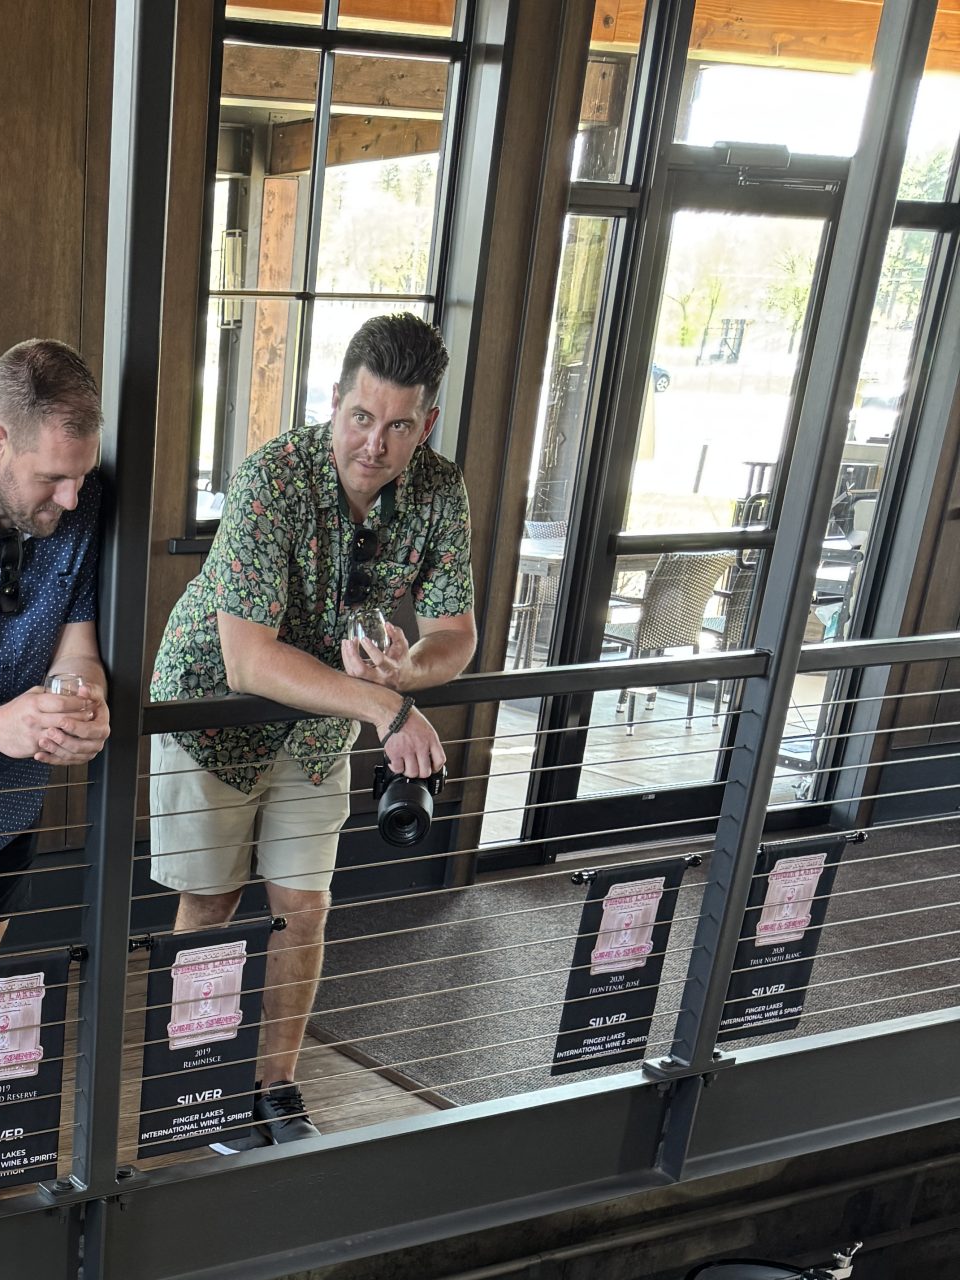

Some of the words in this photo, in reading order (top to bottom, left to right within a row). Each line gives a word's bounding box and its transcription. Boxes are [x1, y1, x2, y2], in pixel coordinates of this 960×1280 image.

[764, 955, 784, 963] NORTH
[589, 984, 624, 994] FRONTENAC
[752, 984, 785, 997] SILVER
[721, 1014, 763, 1026] INTERNATIONAL
[765, 1009, 778, 1018] WINE
[784, 1006, 802, 1014] SPIRITS
[745, 1006, 765, 1014] FINGER
[589, 1013, 626, 1028] SILVER
[583, 1036, 606, 1045] FINGER
[607, 1032, 626, 1040] LAKES
[195, 1048, 211, 1057] 2019
[557, 1045, 603, 1058] INTERNATIONAL
[605, 1040, 620, 1049] WINE
[627, 1036, 648, 1044] SPIRITS
[183, 1056, 221, 1068] REMINISCE
[7, 1091, 37, 1101] RESERVE
[177, 1089, 222, 1106] SILVER
[173, 1114, 199, 1125] FINGER
[201, 1109, 224, 1119] LAKES
[141, 1123, 198, 1140] INTERNATIONAL
[200, 1118, 219, 1127] WINE
[227, 1111, 252, 1122] SPIRITS
[1, 1159, 21, 1168] WINE
[30, 1152, 57, 1163] SPIRITS
[2, 1149, 26, 1159] LAKES
